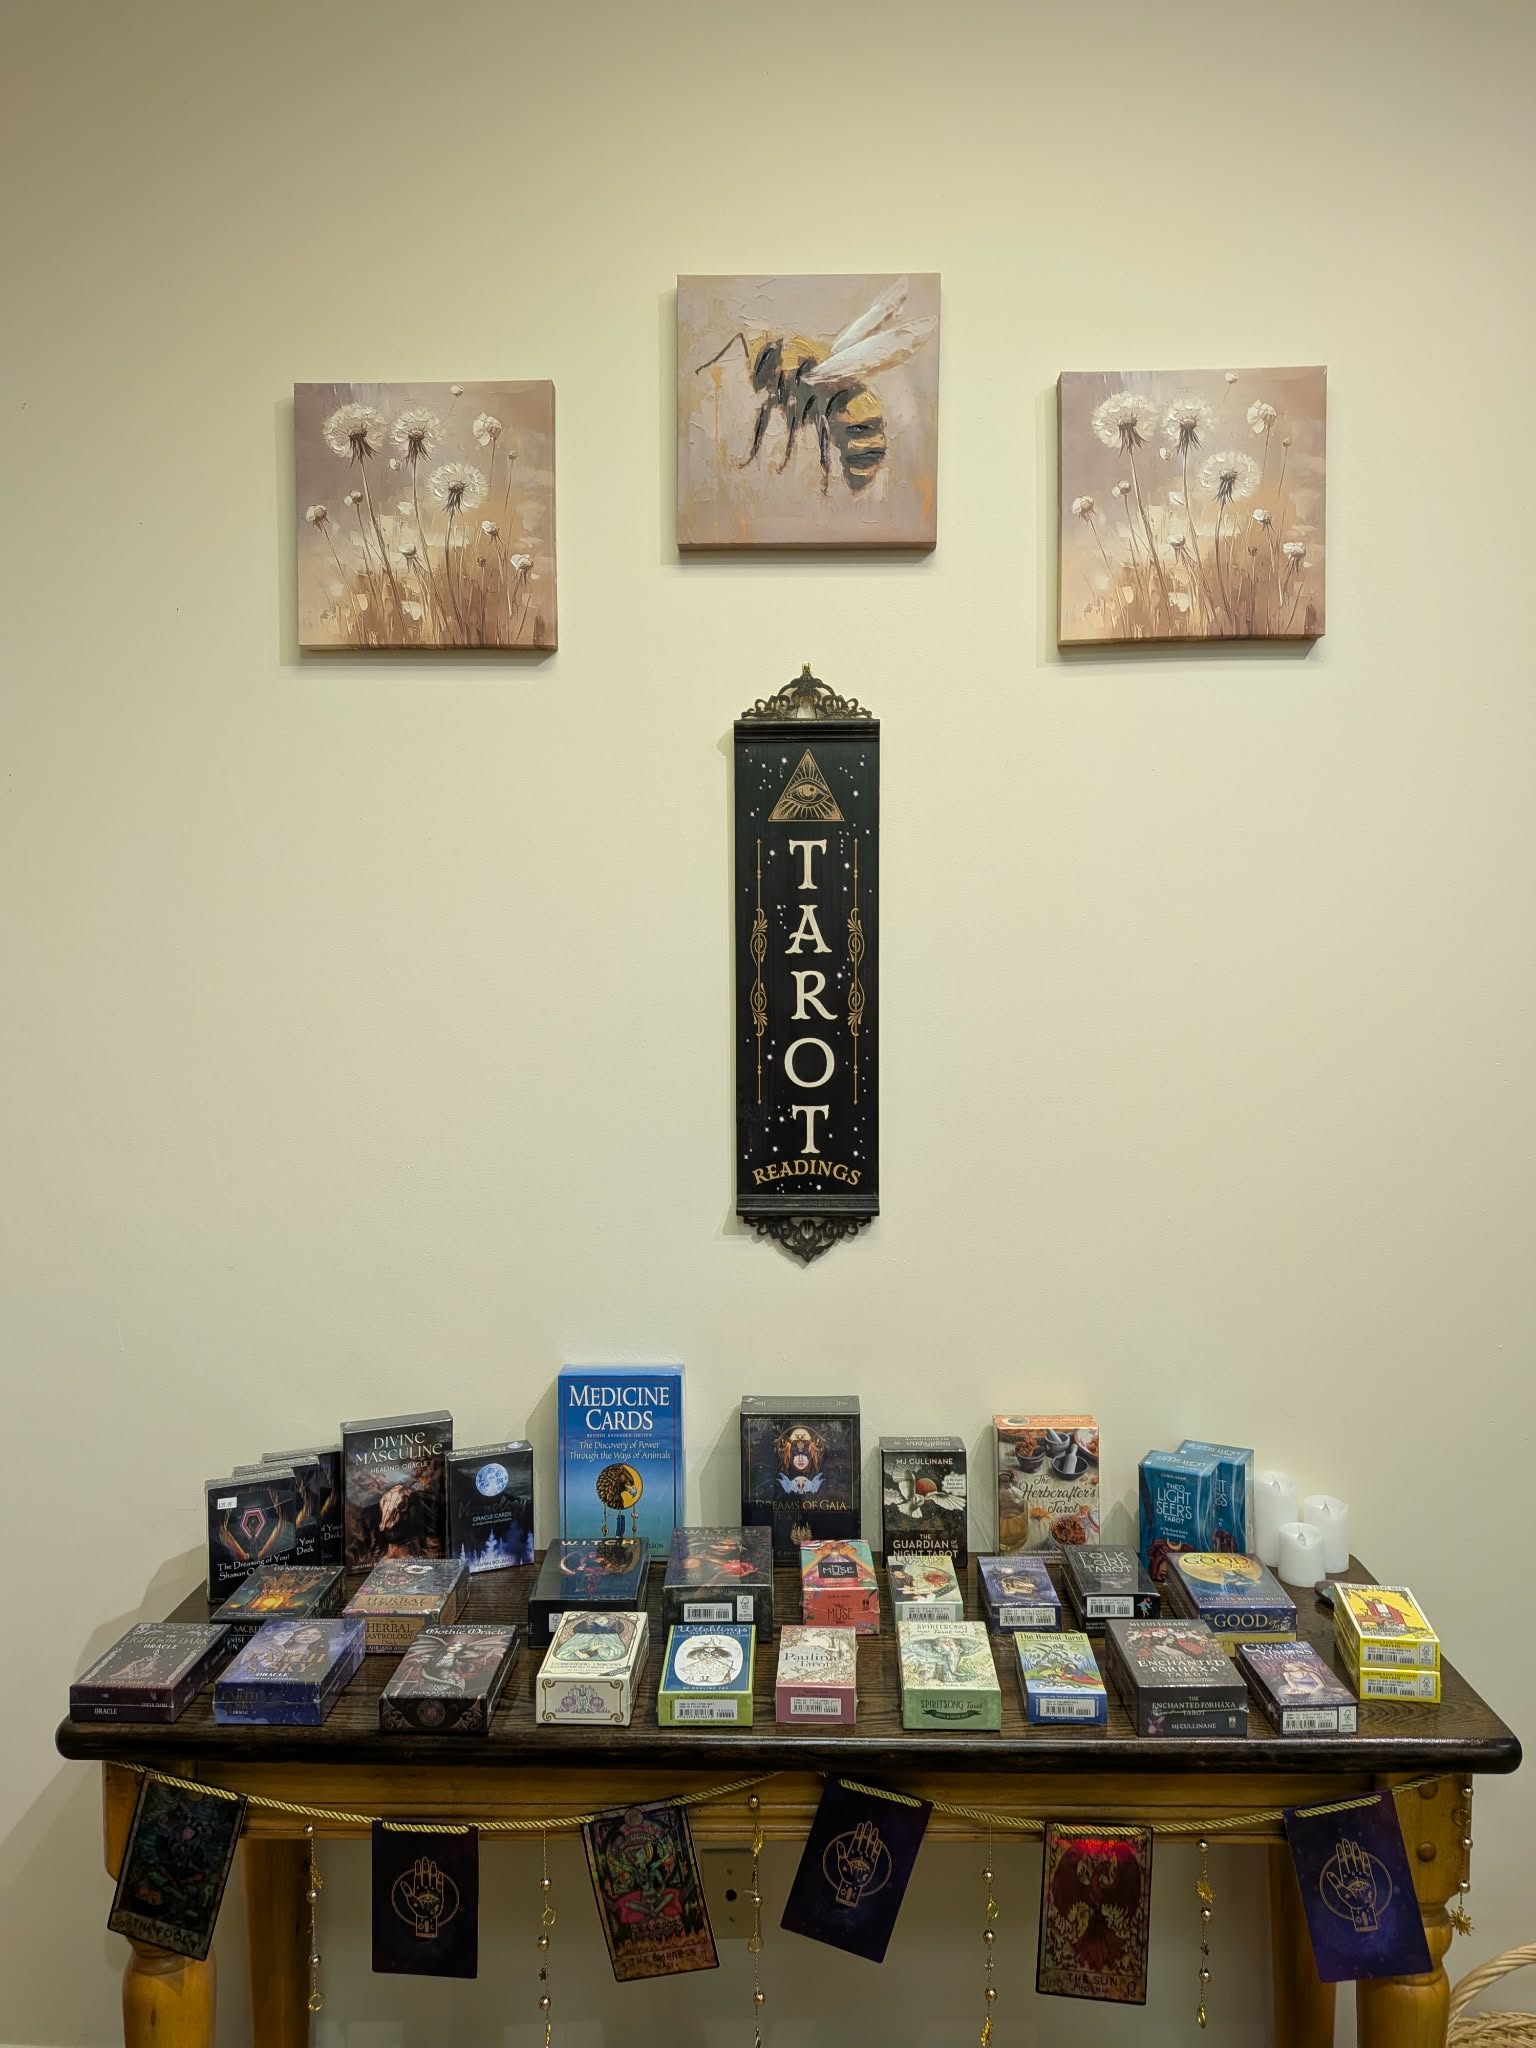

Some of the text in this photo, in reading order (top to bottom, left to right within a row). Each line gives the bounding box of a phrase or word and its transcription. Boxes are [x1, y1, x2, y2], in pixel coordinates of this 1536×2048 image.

[784, 838, 838, 1154] TAROT
[752, 1158, 862, 1186] READINGS
[568, 1385, 670, 1407] MEDICINE
[585, 1408, 653, 1431] CARDS
[374, 1431, 426, 1450] DIVINE
[579, 1440, 661, 1452] The Discovery of Power
[355, 1442, 443, 1466] MASCULINE
[570, 1450, 671, 1463] Through the Ways of Animals
[370, 1460, 429, 1475] HEALING ORACLE
[1033, 1473, 1051, 1485] The
[1018, 1482, 1096, 1501] Herbcrafter's
[1166, 1483, 1186, 1493] THE
[1157, 1488, 1191, 1505] LIGHT
[802, 1500, 819, 1511] OF
[820, 1499, 848, 1511] GAIA
[1047, 1501, 1080, 1514] Tarot
[1156, 1501, 1192, 1520] SEER'S
[472, 1513, 493, 1522] ORACLE
[493, 1511, 512, 1520] CARDS
[1164, 1515, 1185, 1524] TAROT
[892, 1539, 949, 1549] GUARDIAN
[296, 1546, 314, 1556] Deck
[217, 1563, 232, 1573] The
[233, 1559, 265, 1570] Dreaming
[273, 1554, 290, 1563] You!
[1184, 1556, 1249, 1565] GOOD
[218, 1570, 246, 1581] Shaman
[822, 1565, 855, 1575] MUSE
[827, 1607, 856, 1620] MUSE
[1214, 1614, 1268, 1628] GOOD
[233, 1625, 260, 1633] SACR
[365, 1623, 414, 1633] HERBAL
[678, 1625, 748, 1634] Witchlings
[916, 1624, 968, 1633] SPIRITSONG
[122, 1636, 155, 1644] LIGHT
[178, 1637, 208, 1645] DARK
[1035, 1633, 1062, 1641] Herbal
[266, 1663, 312, 1673] SKY
[796, 1660, 830, 1668] Tarot
[1137, 1659, 1226, 1668] ENCHANTED
[920, 1700, 964, 1709] SPIRITSONG
[1068, 1973, 1118, 1986] THE SUN
